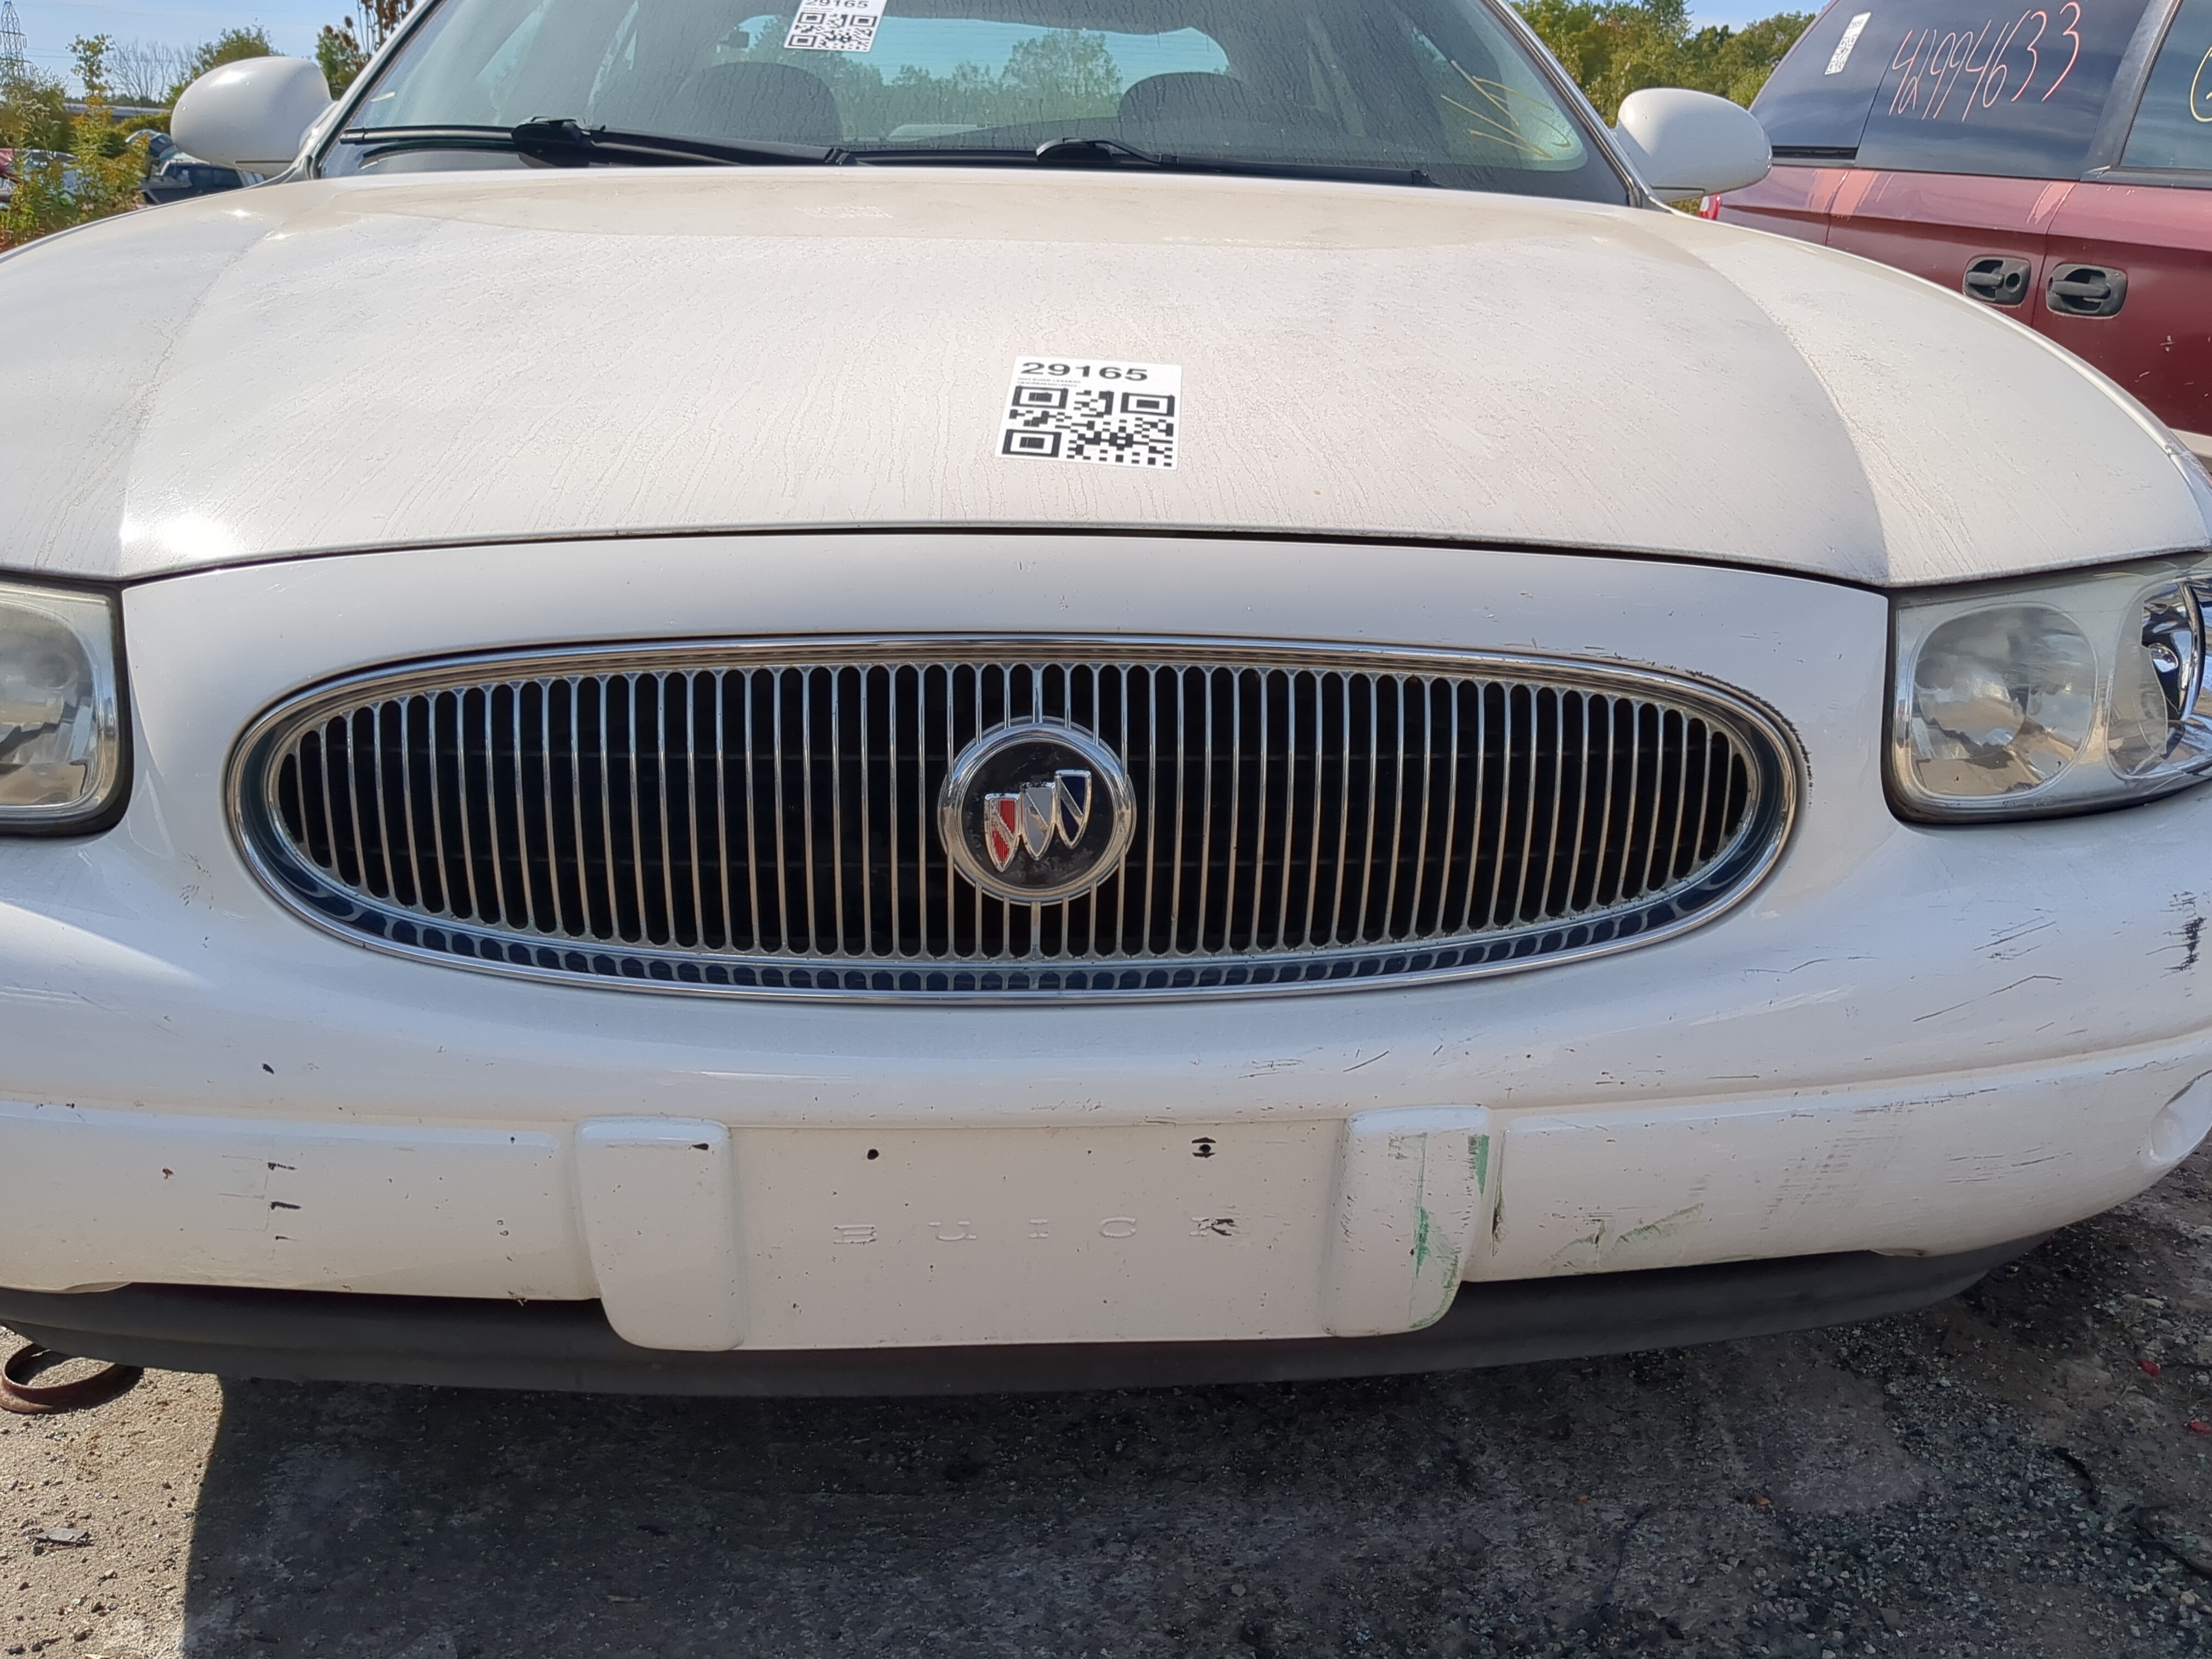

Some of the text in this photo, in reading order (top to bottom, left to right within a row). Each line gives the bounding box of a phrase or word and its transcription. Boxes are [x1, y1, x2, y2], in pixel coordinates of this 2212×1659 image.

[805, 0, 868, 8] 29165
[1020, 362, 1148, 381] 29165
[833, 1216, 1235, 1244] BUICK
